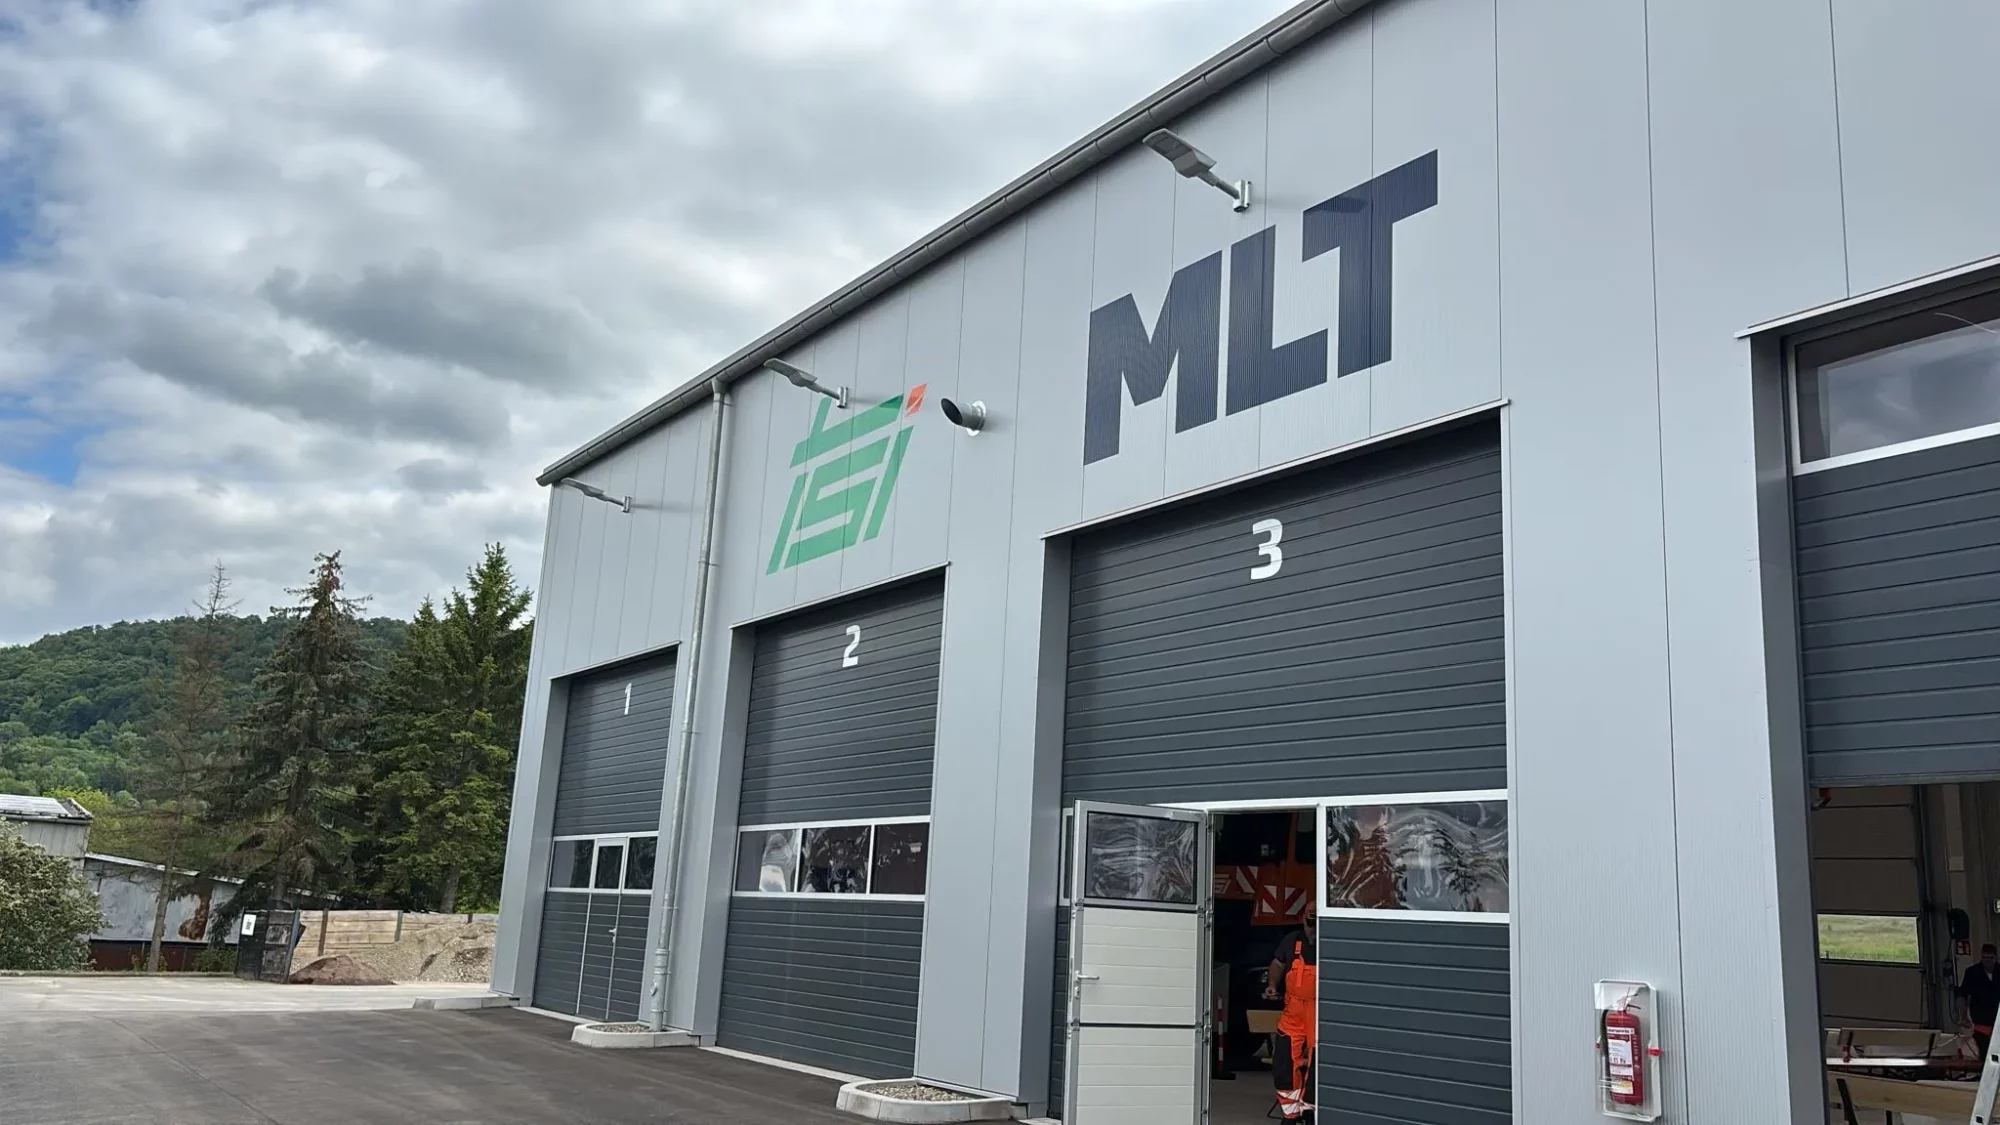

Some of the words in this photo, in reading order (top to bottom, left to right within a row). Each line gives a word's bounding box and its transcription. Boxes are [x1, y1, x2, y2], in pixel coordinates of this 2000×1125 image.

[1083, 149, 1438, 466] MLT
[1250, 518, 1283, 580] 3
[841, 624, 861, 668] 2
[623, 682, 633, 716] 1
